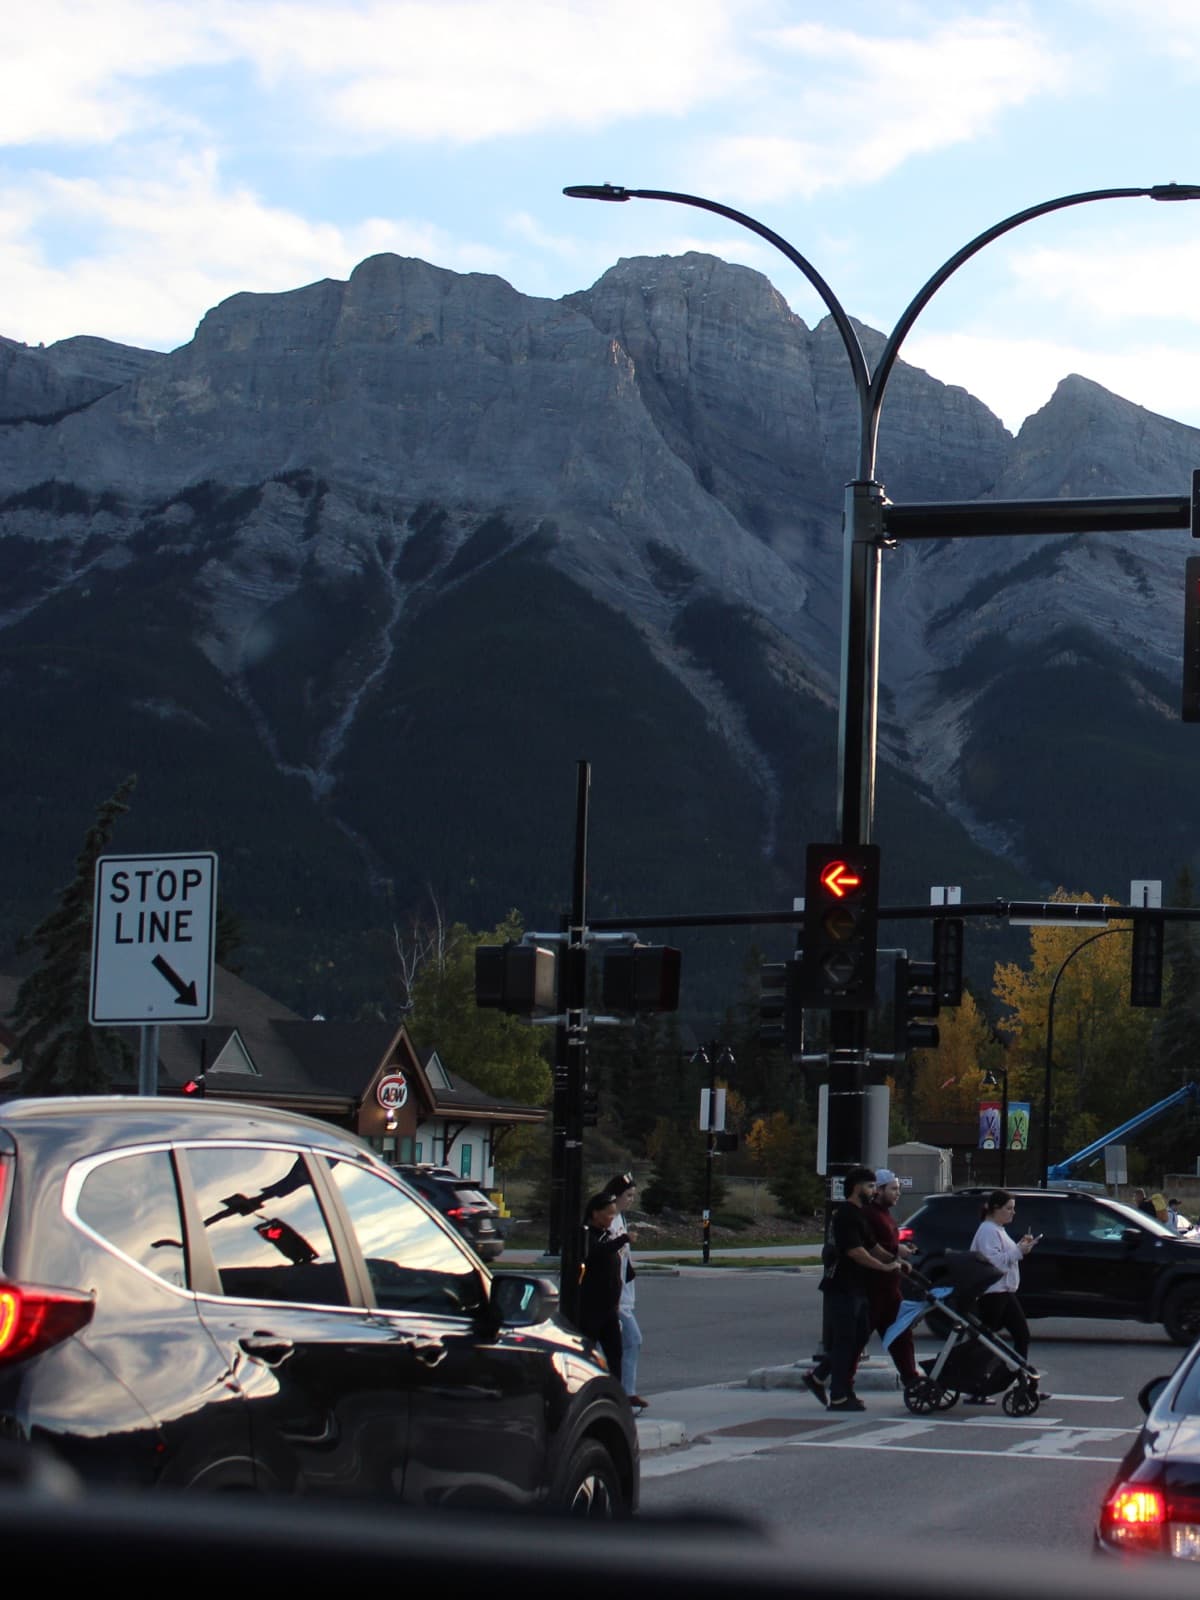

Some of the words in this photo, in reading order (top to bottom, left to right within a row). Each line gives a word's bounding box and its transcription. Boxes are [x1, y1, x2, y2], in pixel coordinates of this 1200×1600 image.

[110, 869, 202, 903] STOP
[115, 910, 193, 944] LINE
[383, 1087, 406, 1103] A&W
